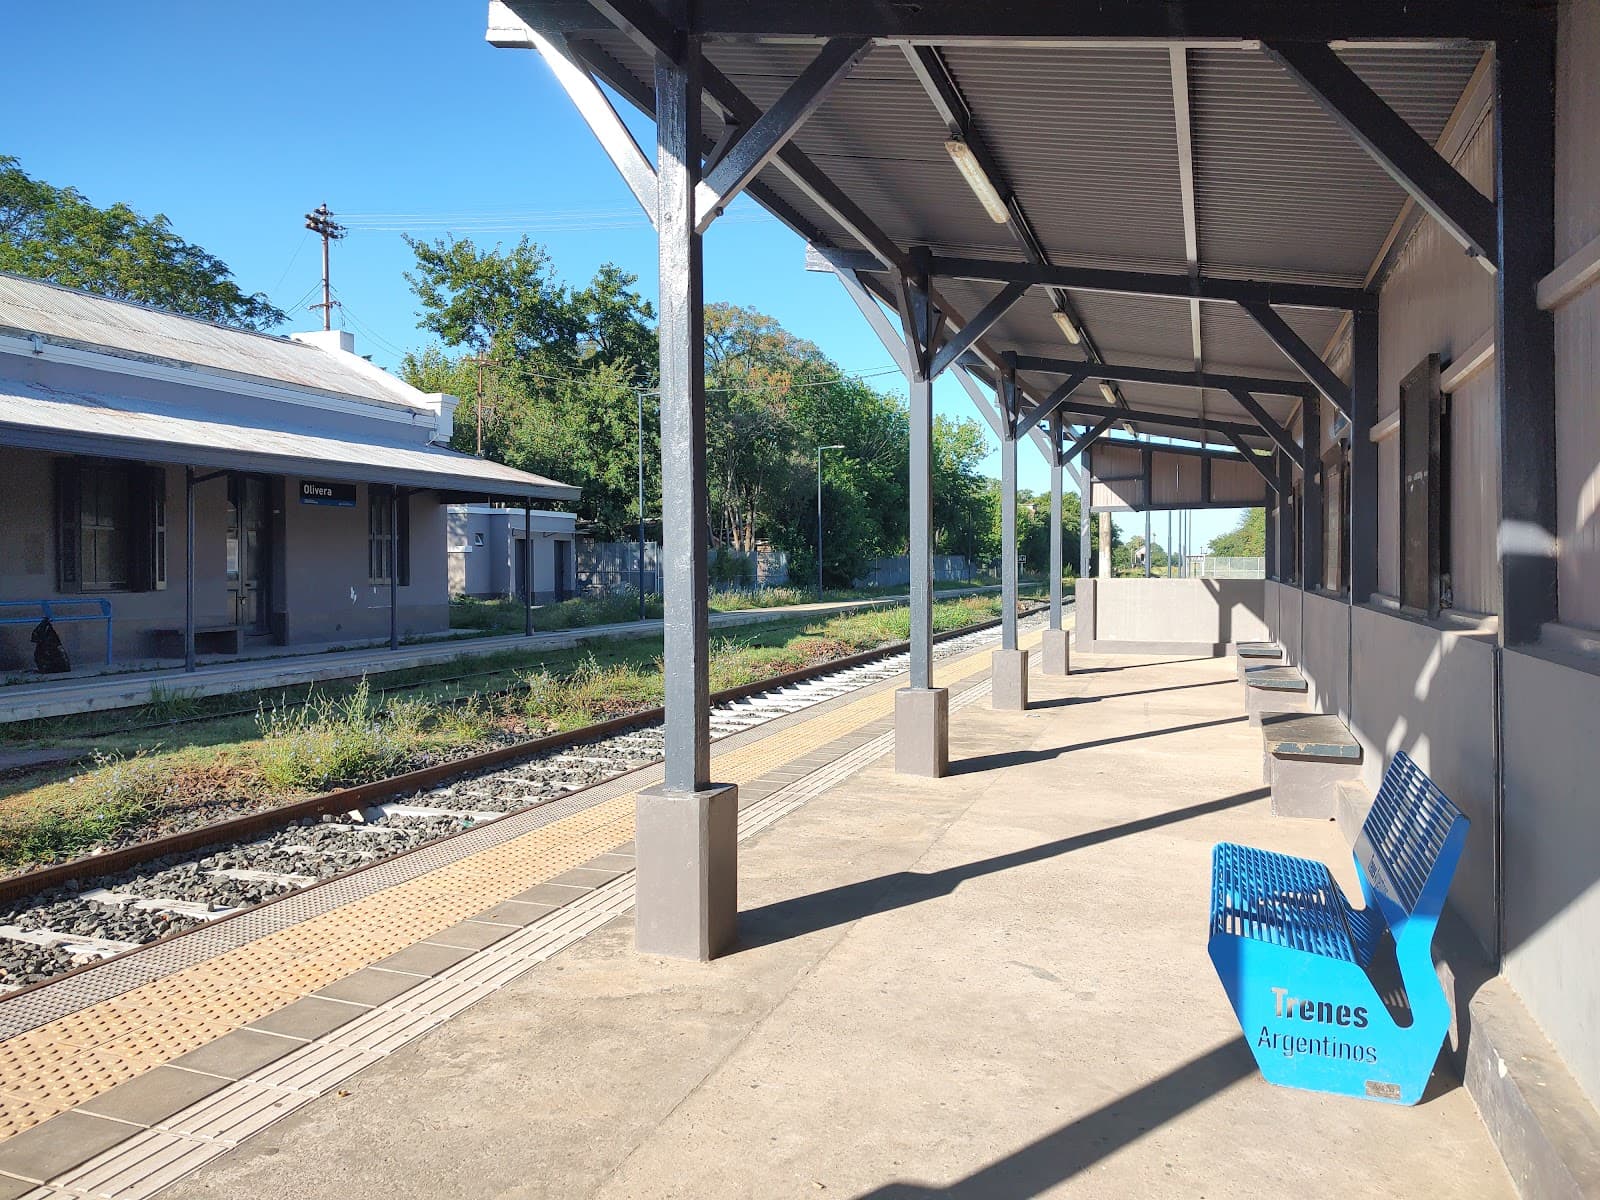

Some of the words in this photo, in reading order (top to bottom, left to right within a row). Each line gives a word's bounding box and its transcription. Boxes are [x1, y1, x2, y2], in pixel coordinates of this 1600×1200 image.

[303, 484, 332, 496] Olivera
[1271, 987, 1369, 1029] Trenes
[1257, 1026, 1377, 1063] Argentinos
